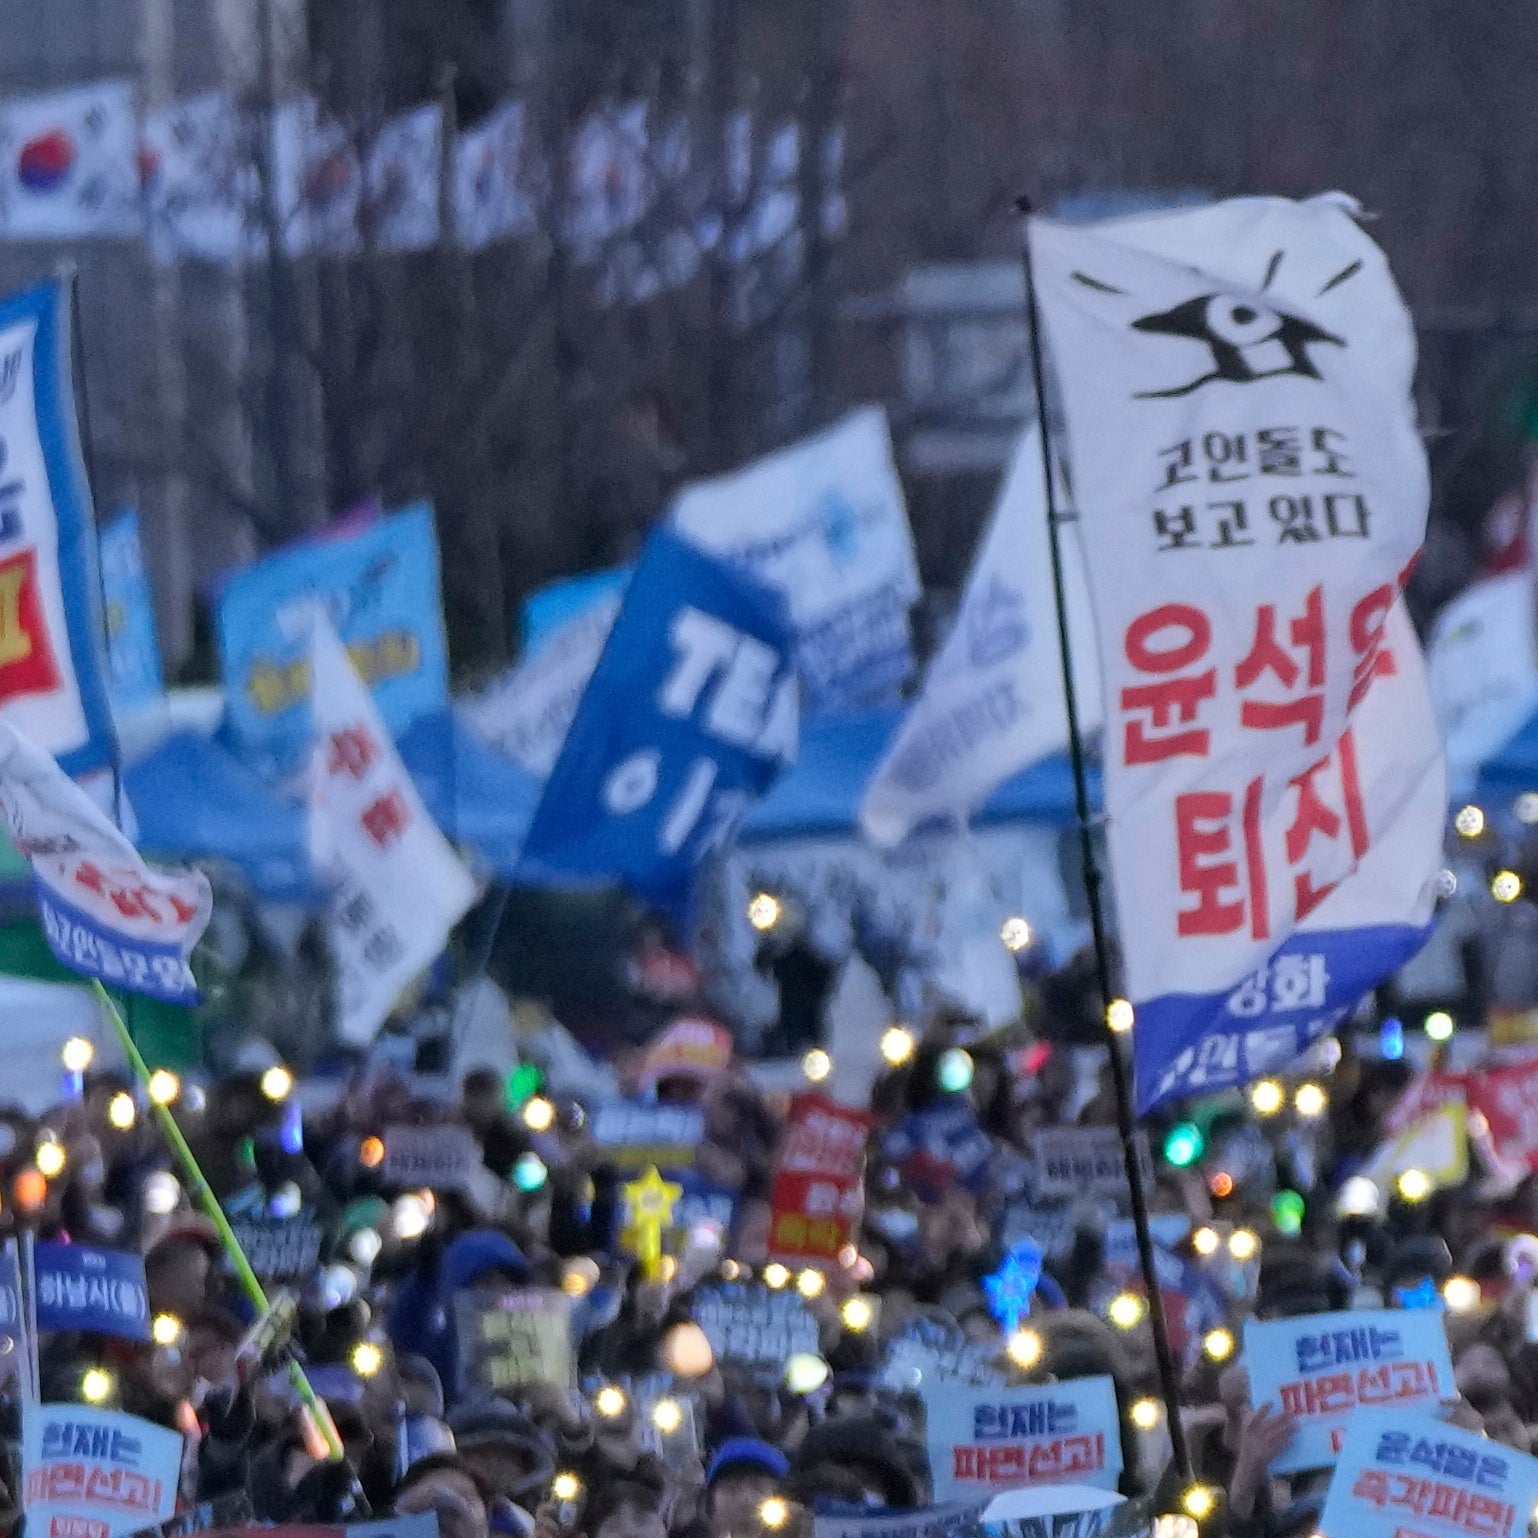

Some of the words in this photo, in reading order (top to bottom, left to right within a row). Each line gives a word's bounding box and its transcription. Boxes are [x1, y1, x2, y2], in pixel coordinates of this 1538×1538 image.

[1156, 424, 1356, 490] 고인돌도
[1153, 499, 1255, 552] 보고
[1268, 491, 1373, 546] 있다
[1174, 747, 1371, 940] 퇴진
